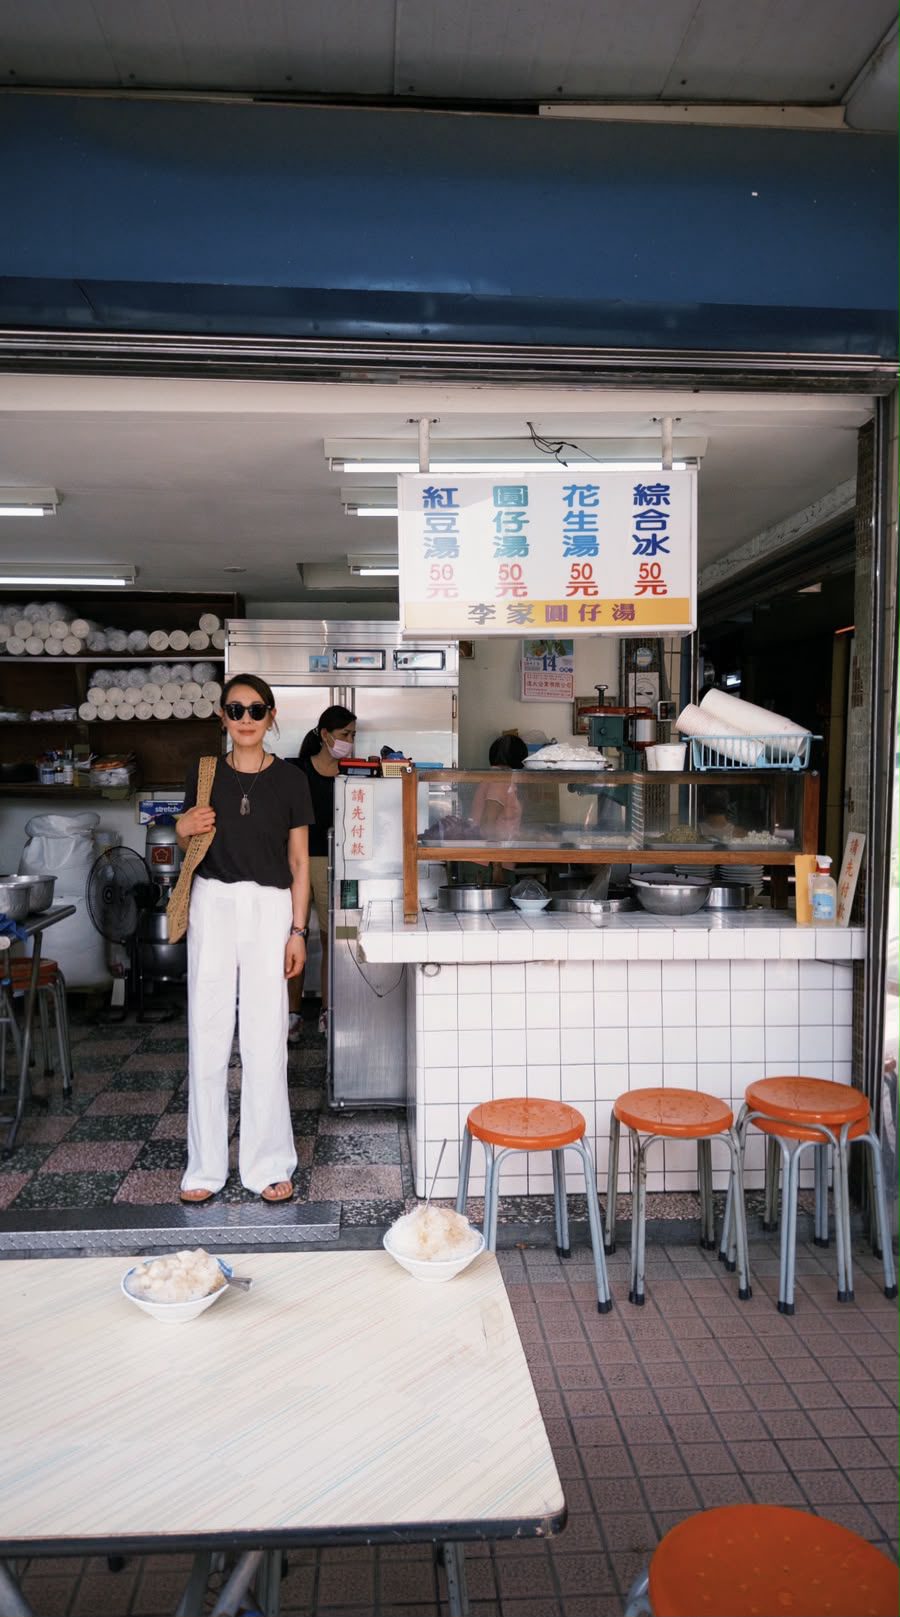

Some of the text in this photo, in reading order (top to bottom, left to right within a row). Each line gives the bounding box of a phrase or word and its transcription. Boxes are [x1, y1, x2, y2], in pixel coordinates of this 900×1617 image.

[422, 486, 460, 559] 紅豆湯
[492, 485, 530, 558] 圓仔湯
[562, 484, 600, 557] 花生湯
[632, 483, 671, 556] 綜合冰
[467, 603, 636, 626] 李家圓仔湯
[542, 654, 557, 672] 14
[351, 788, 366, 856] 請先付款
